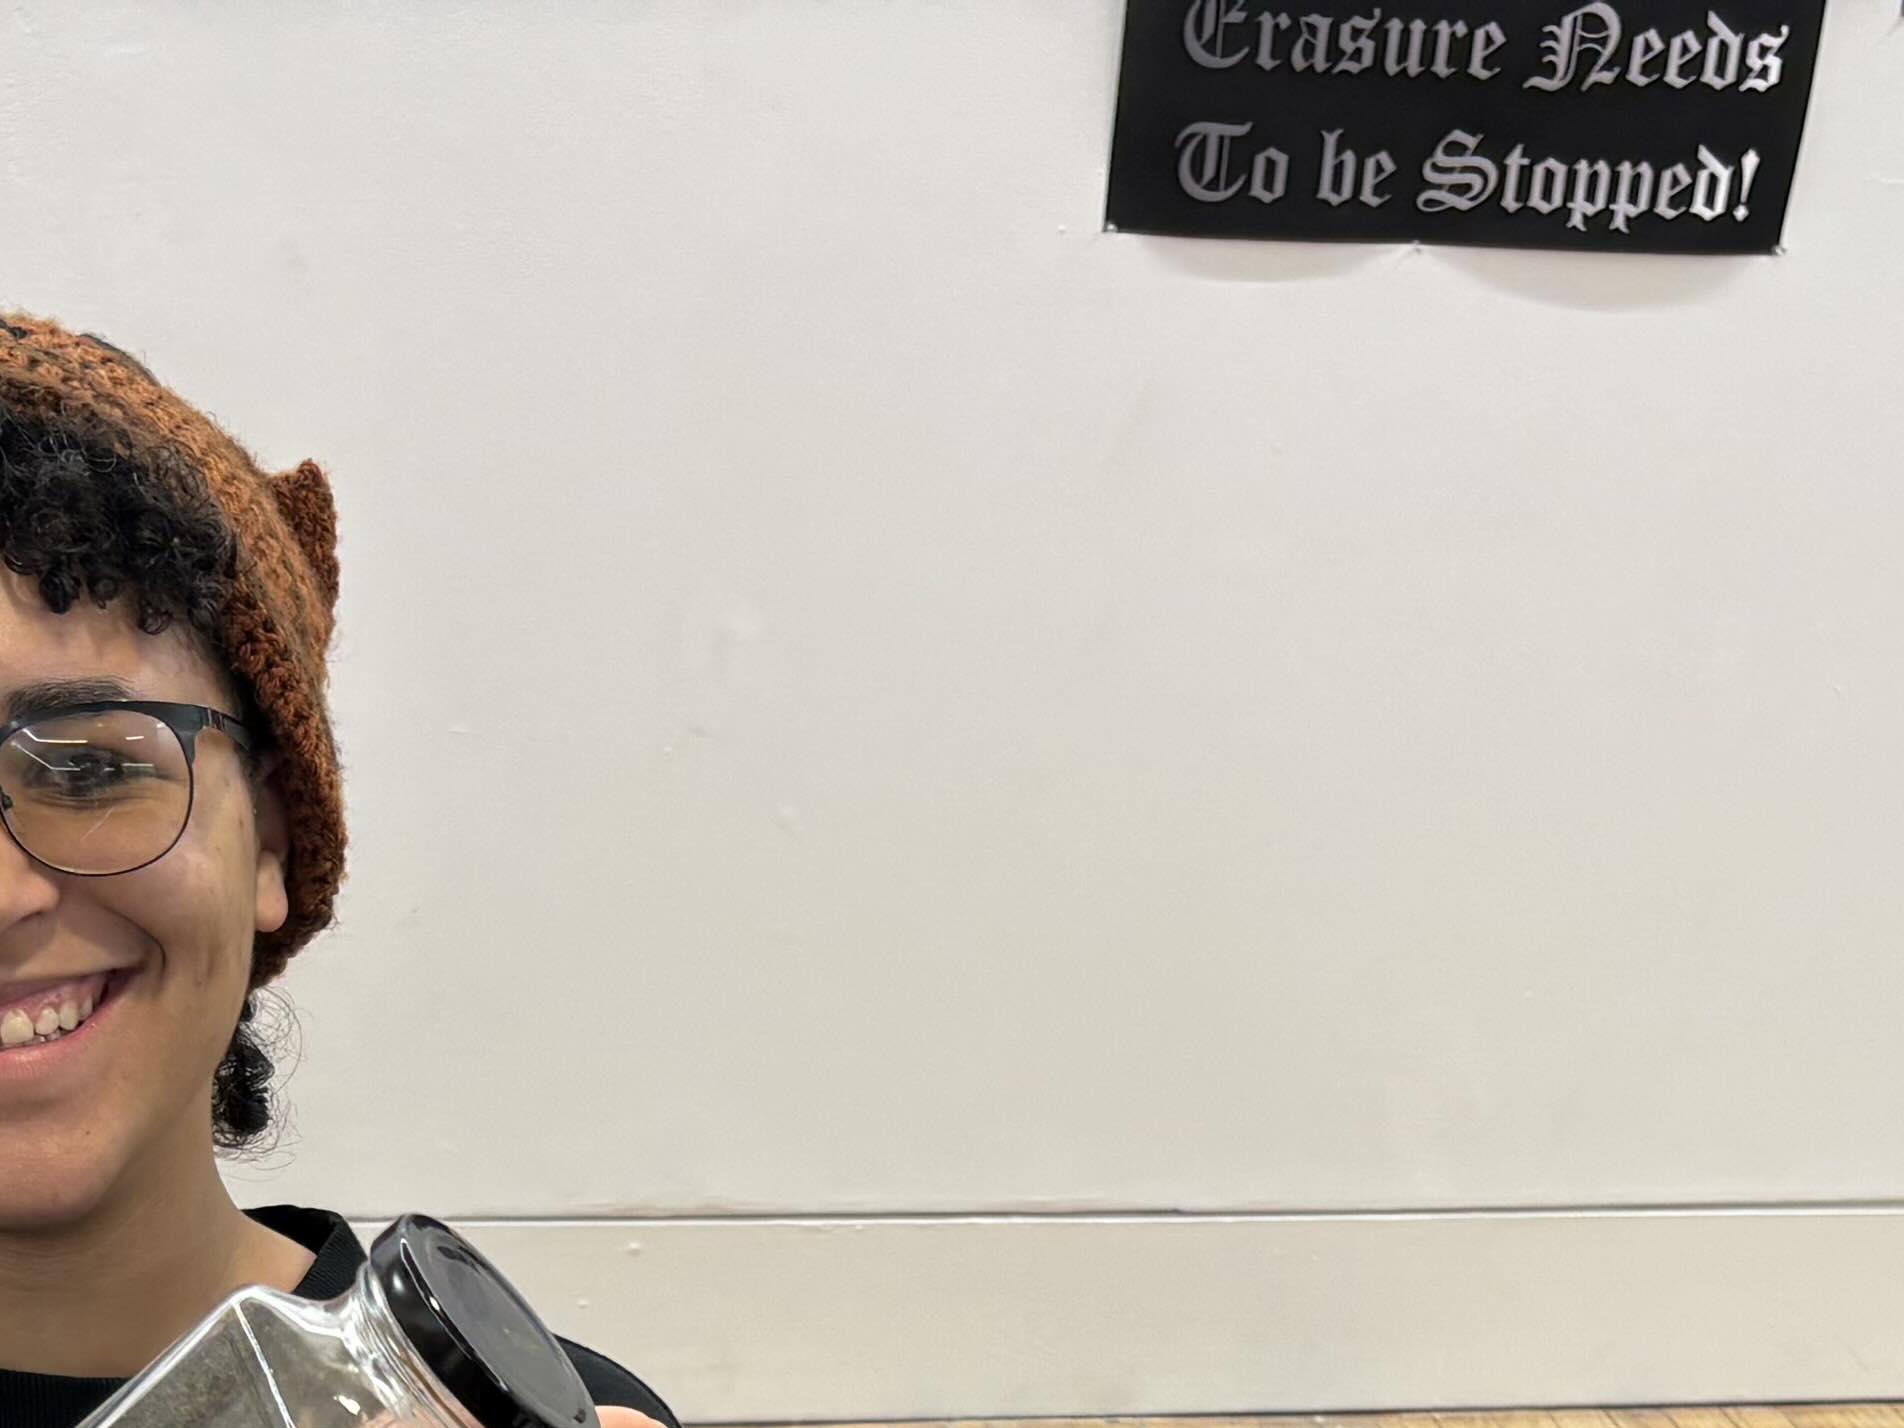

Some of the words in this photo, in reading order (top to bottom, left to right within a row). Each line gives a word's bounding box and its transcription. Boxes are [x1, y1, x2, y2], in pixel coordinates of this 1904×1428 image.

[1183, 0, 1507, 81] Erasure
[1522, 2, 1790, 93] Needs
[1174, 121, 1290, 205] To
[1316, 128, 1397, 208] be
[1415, 129, 1761, 234] Stopped!
